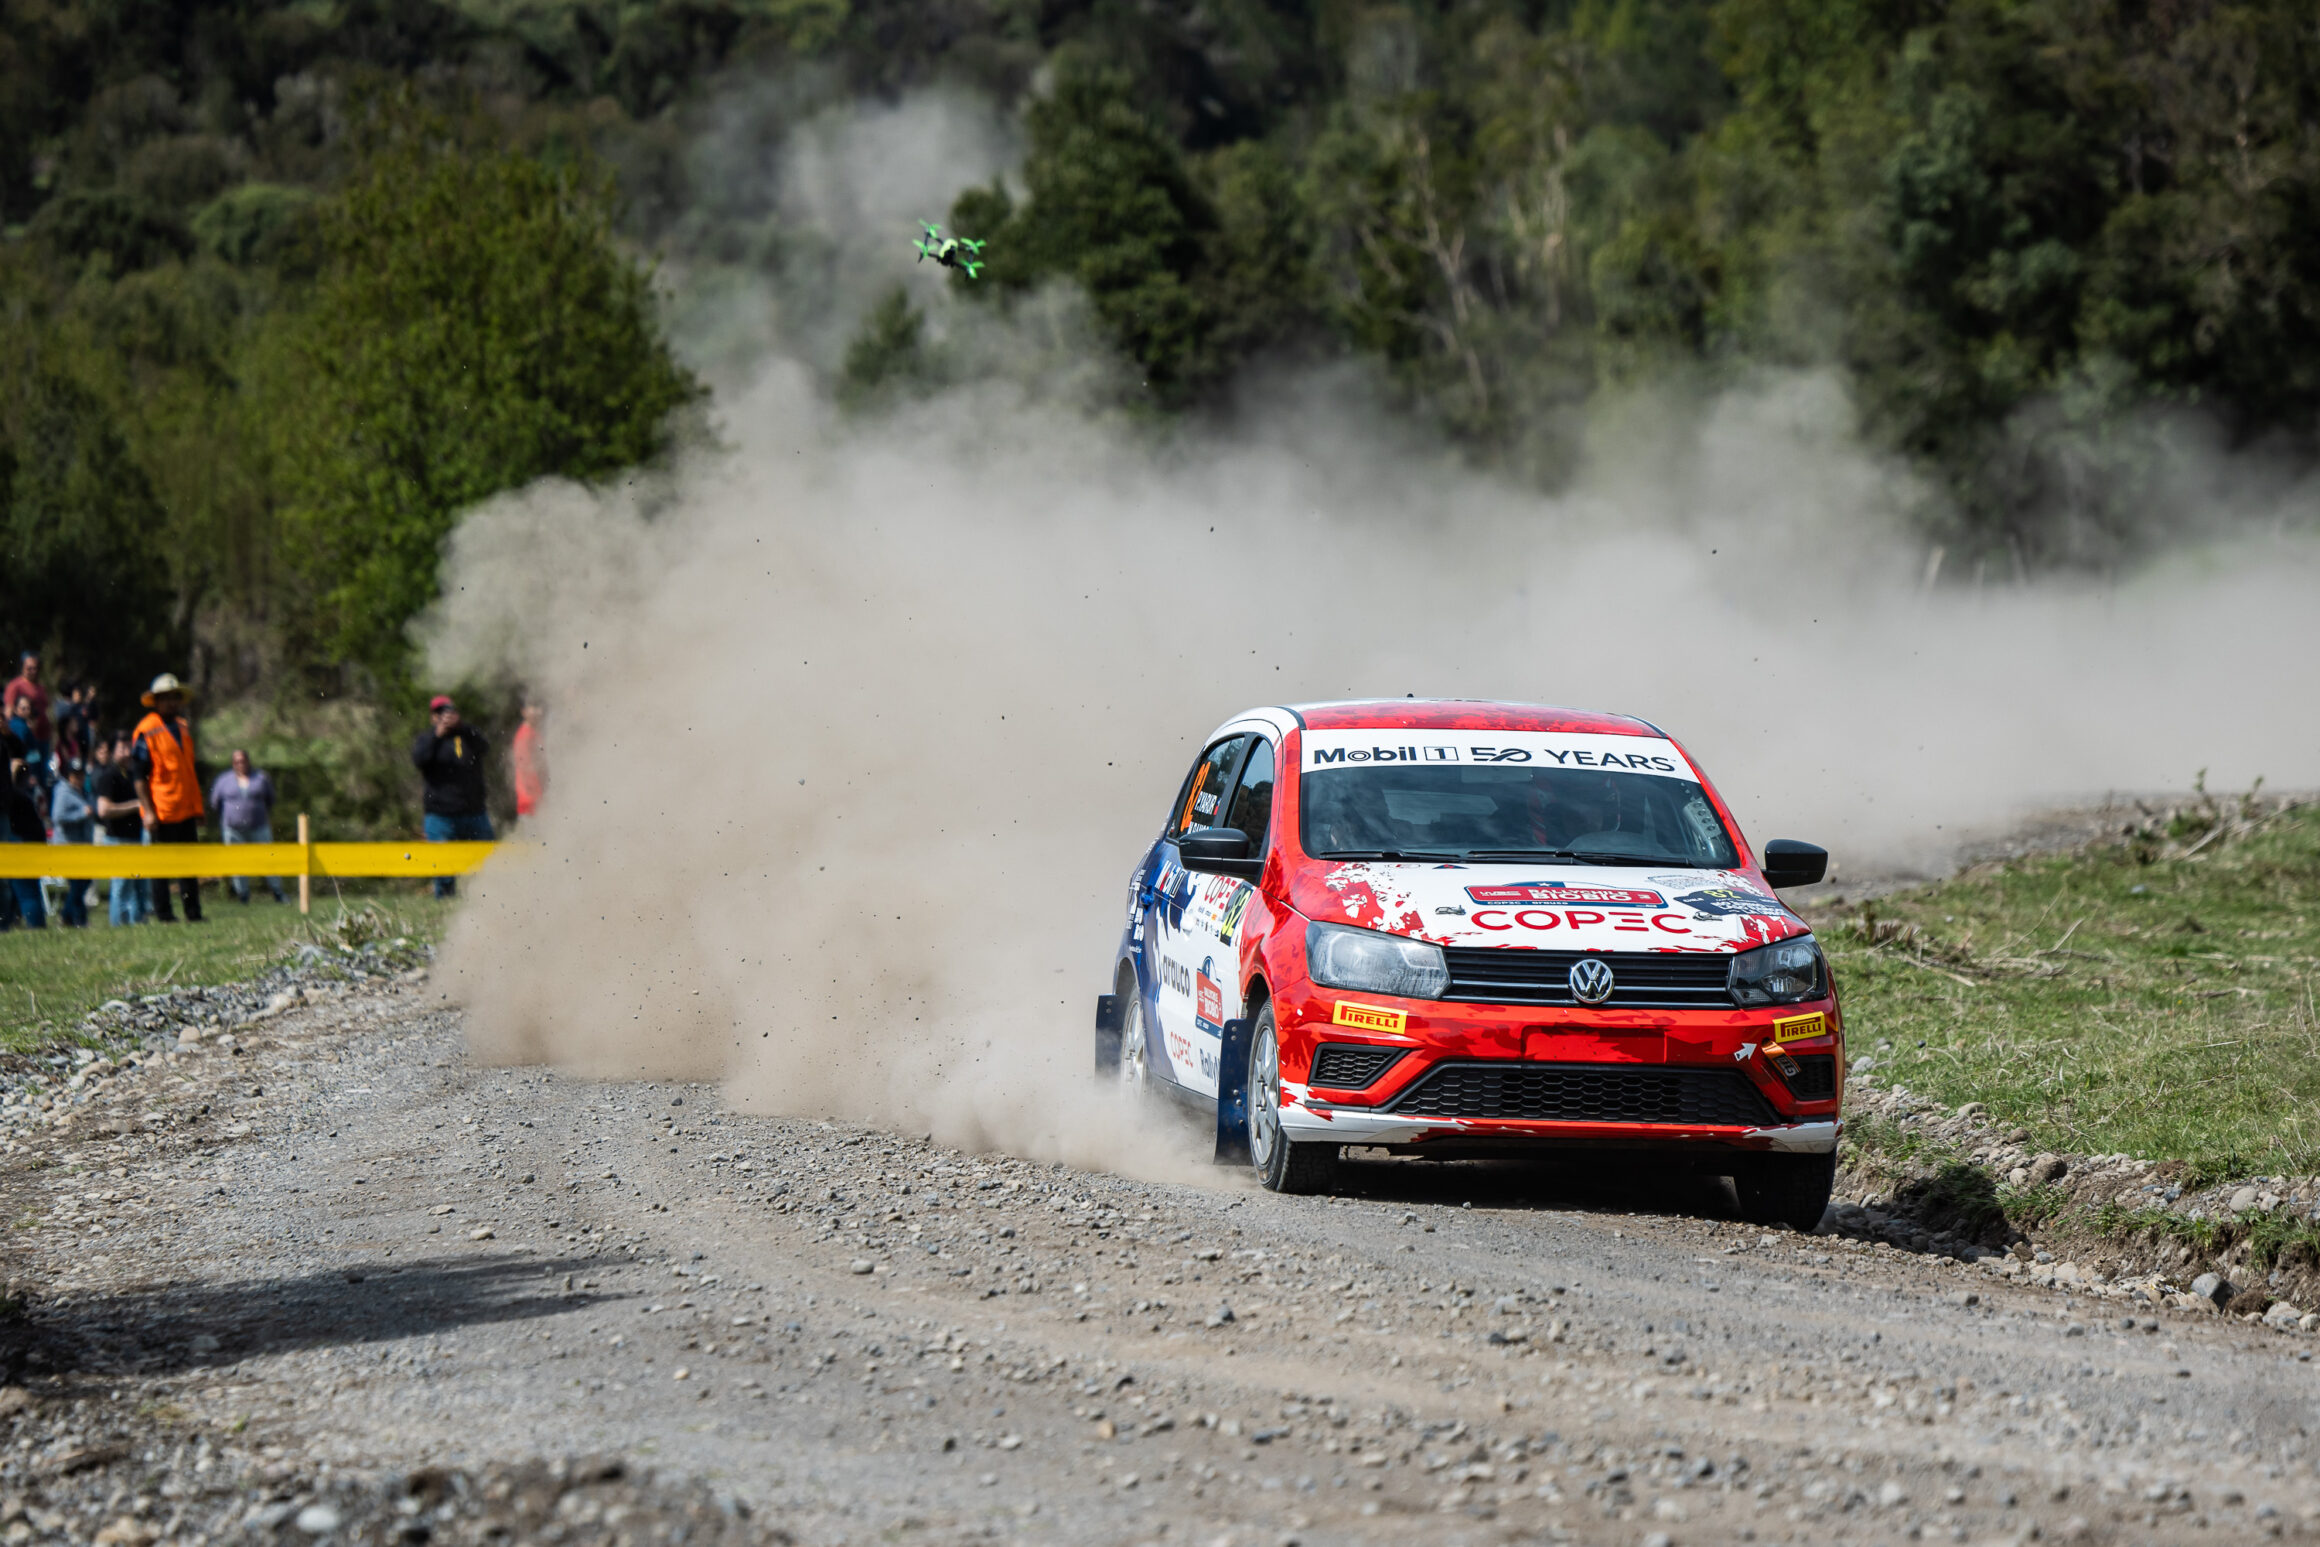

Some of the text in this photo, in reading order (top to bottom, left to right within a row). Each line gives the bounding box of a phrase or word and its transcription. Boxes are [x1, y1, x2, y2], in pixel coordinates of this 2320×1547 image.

[1313, 746, 1417, 764] Mobil
[1470, 747, 1532, 762] 50
[1544, 749, 1676, 772] YEARS
[1222, 887, 1251, 937] 82
[1470, 910, 1693, 934] COPEC
[1163, 954, 1190, 998] arauco
[1340, 1005, 1400, 1028] PIRELLI
[1780, 1016, 1822, 1038] PIRELLI
